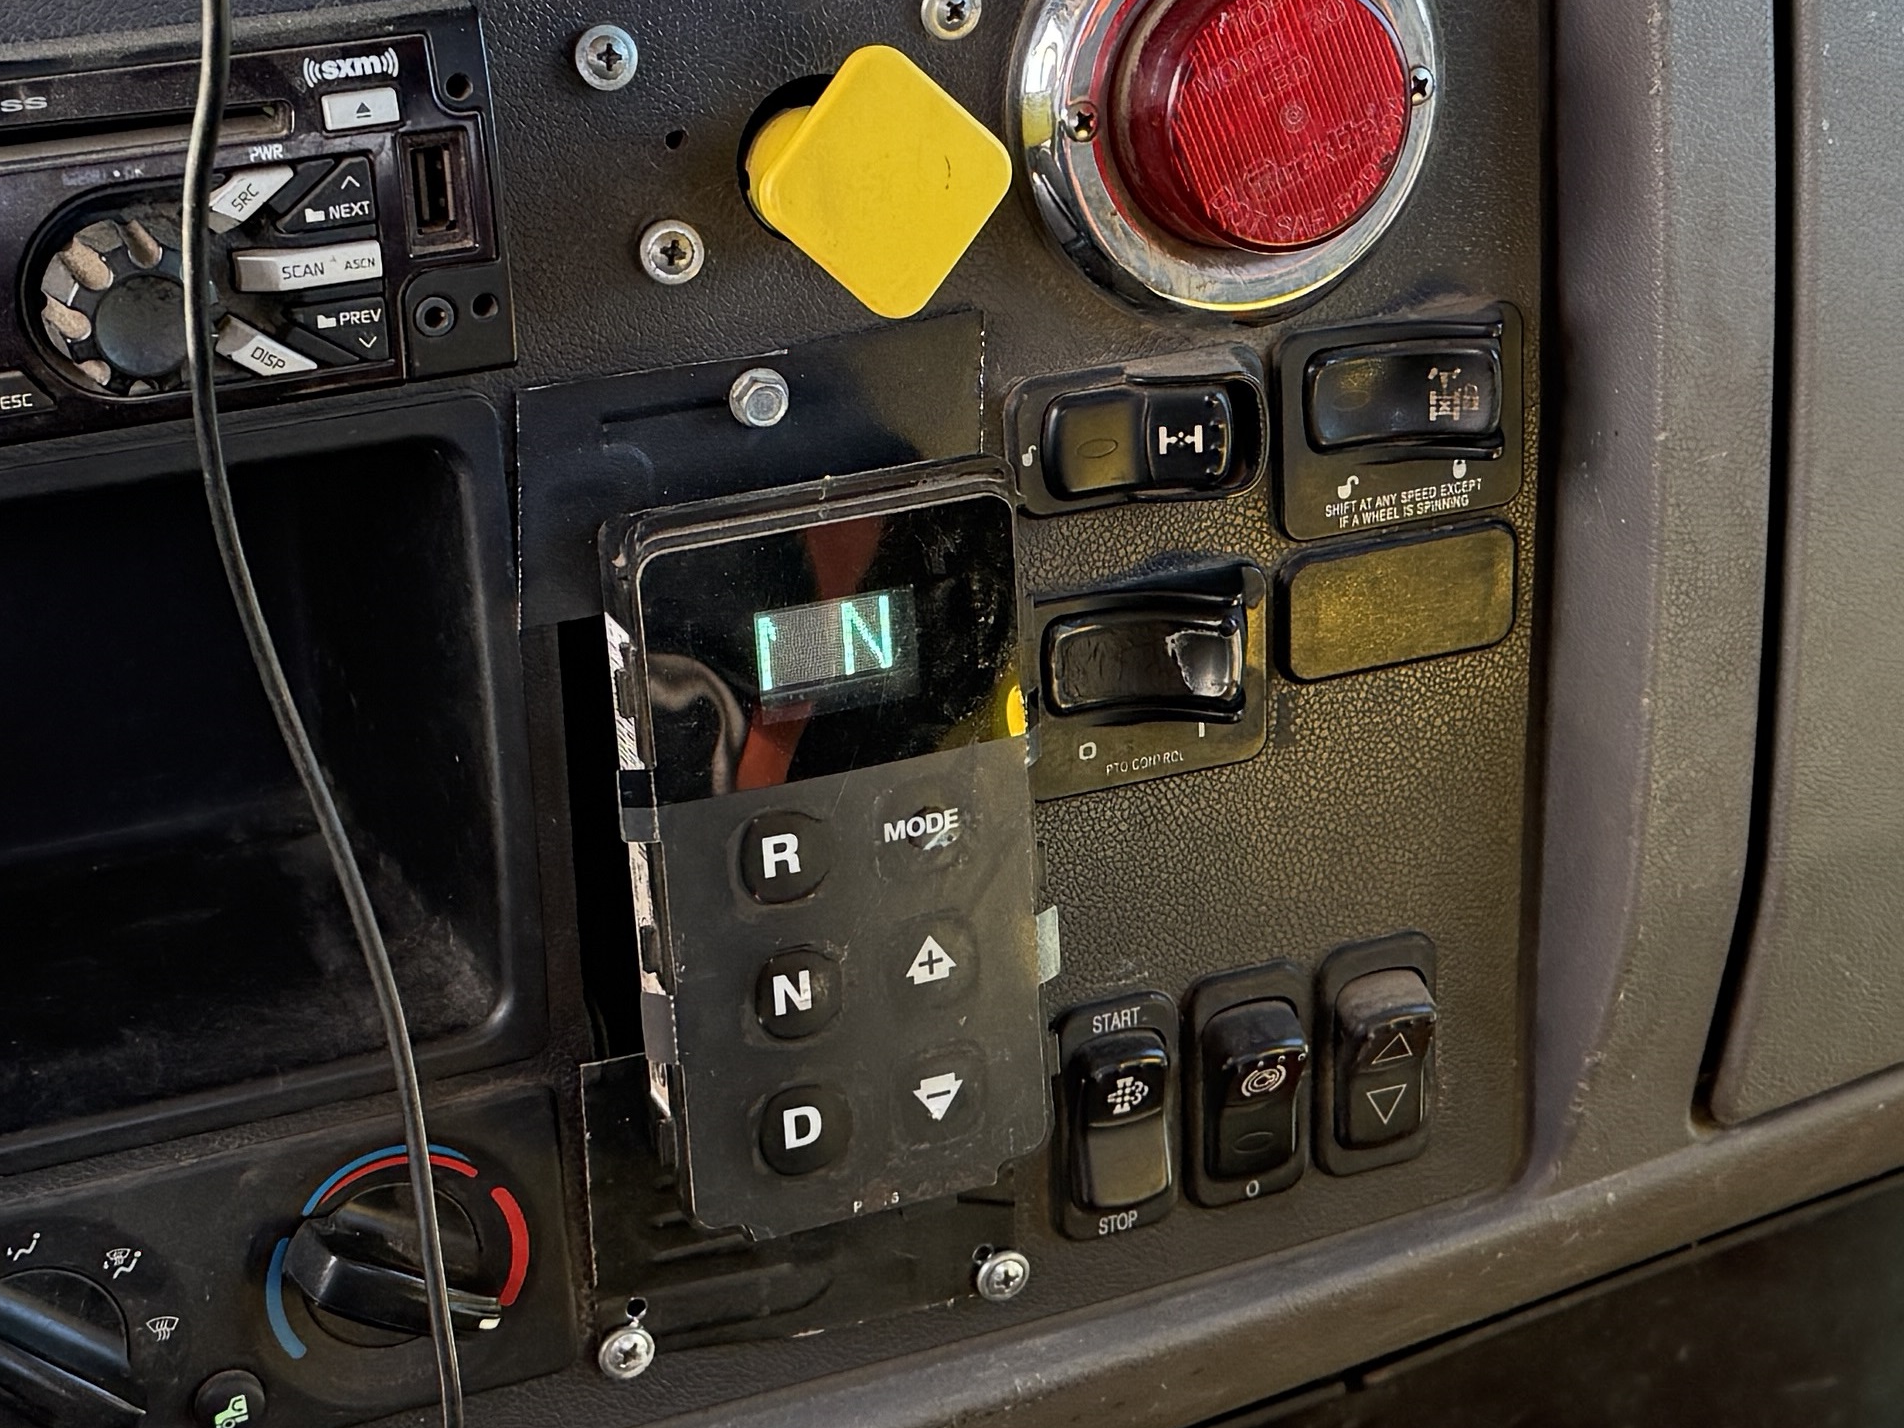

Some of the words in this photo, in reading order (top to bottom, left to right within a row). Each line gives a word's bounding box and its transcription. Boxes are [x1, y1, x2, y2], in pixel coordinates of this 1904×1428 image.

[249, 143, 284, 162] PWR
[231, 183, 260, 212] SRC
[329, 200, 371, 220] NEXT
[282, 262, 325, 280] SCAN
[344, 257, 376, 271] ASCN
[339, 308, 382, 326] PREV
[251, 346, 286, 371] DISP
[0, 391, 34, 412] ESC
[1325, 500, 1357, 518] SHIFT
[1359, 497, 1373, 511] AT
[1376, 493, 1397, 509] ANY
[1401, 486, 1436, 504] SPEED
[1440, 478, 1482, 497] EXCEPT
[1339, 515, 1349, 529] IF
[1351, 514, 1360, 527] A
[1362, 508, 1399, 525] WHEEL
[1403, 504, 1414, 518] IS
[1416, 494, 1470, 515] SPINNING
[841, 594, 893, 676] N
[761, 833, 802, 879] R
[883, 808, 960, 843] MODE
[772, 970, 813, 1016] N
[1092, 1006, 1141, 1033] START
[783, 1106, 823, 1150] D
[1098, 1210, 1138, 1235] STOP
